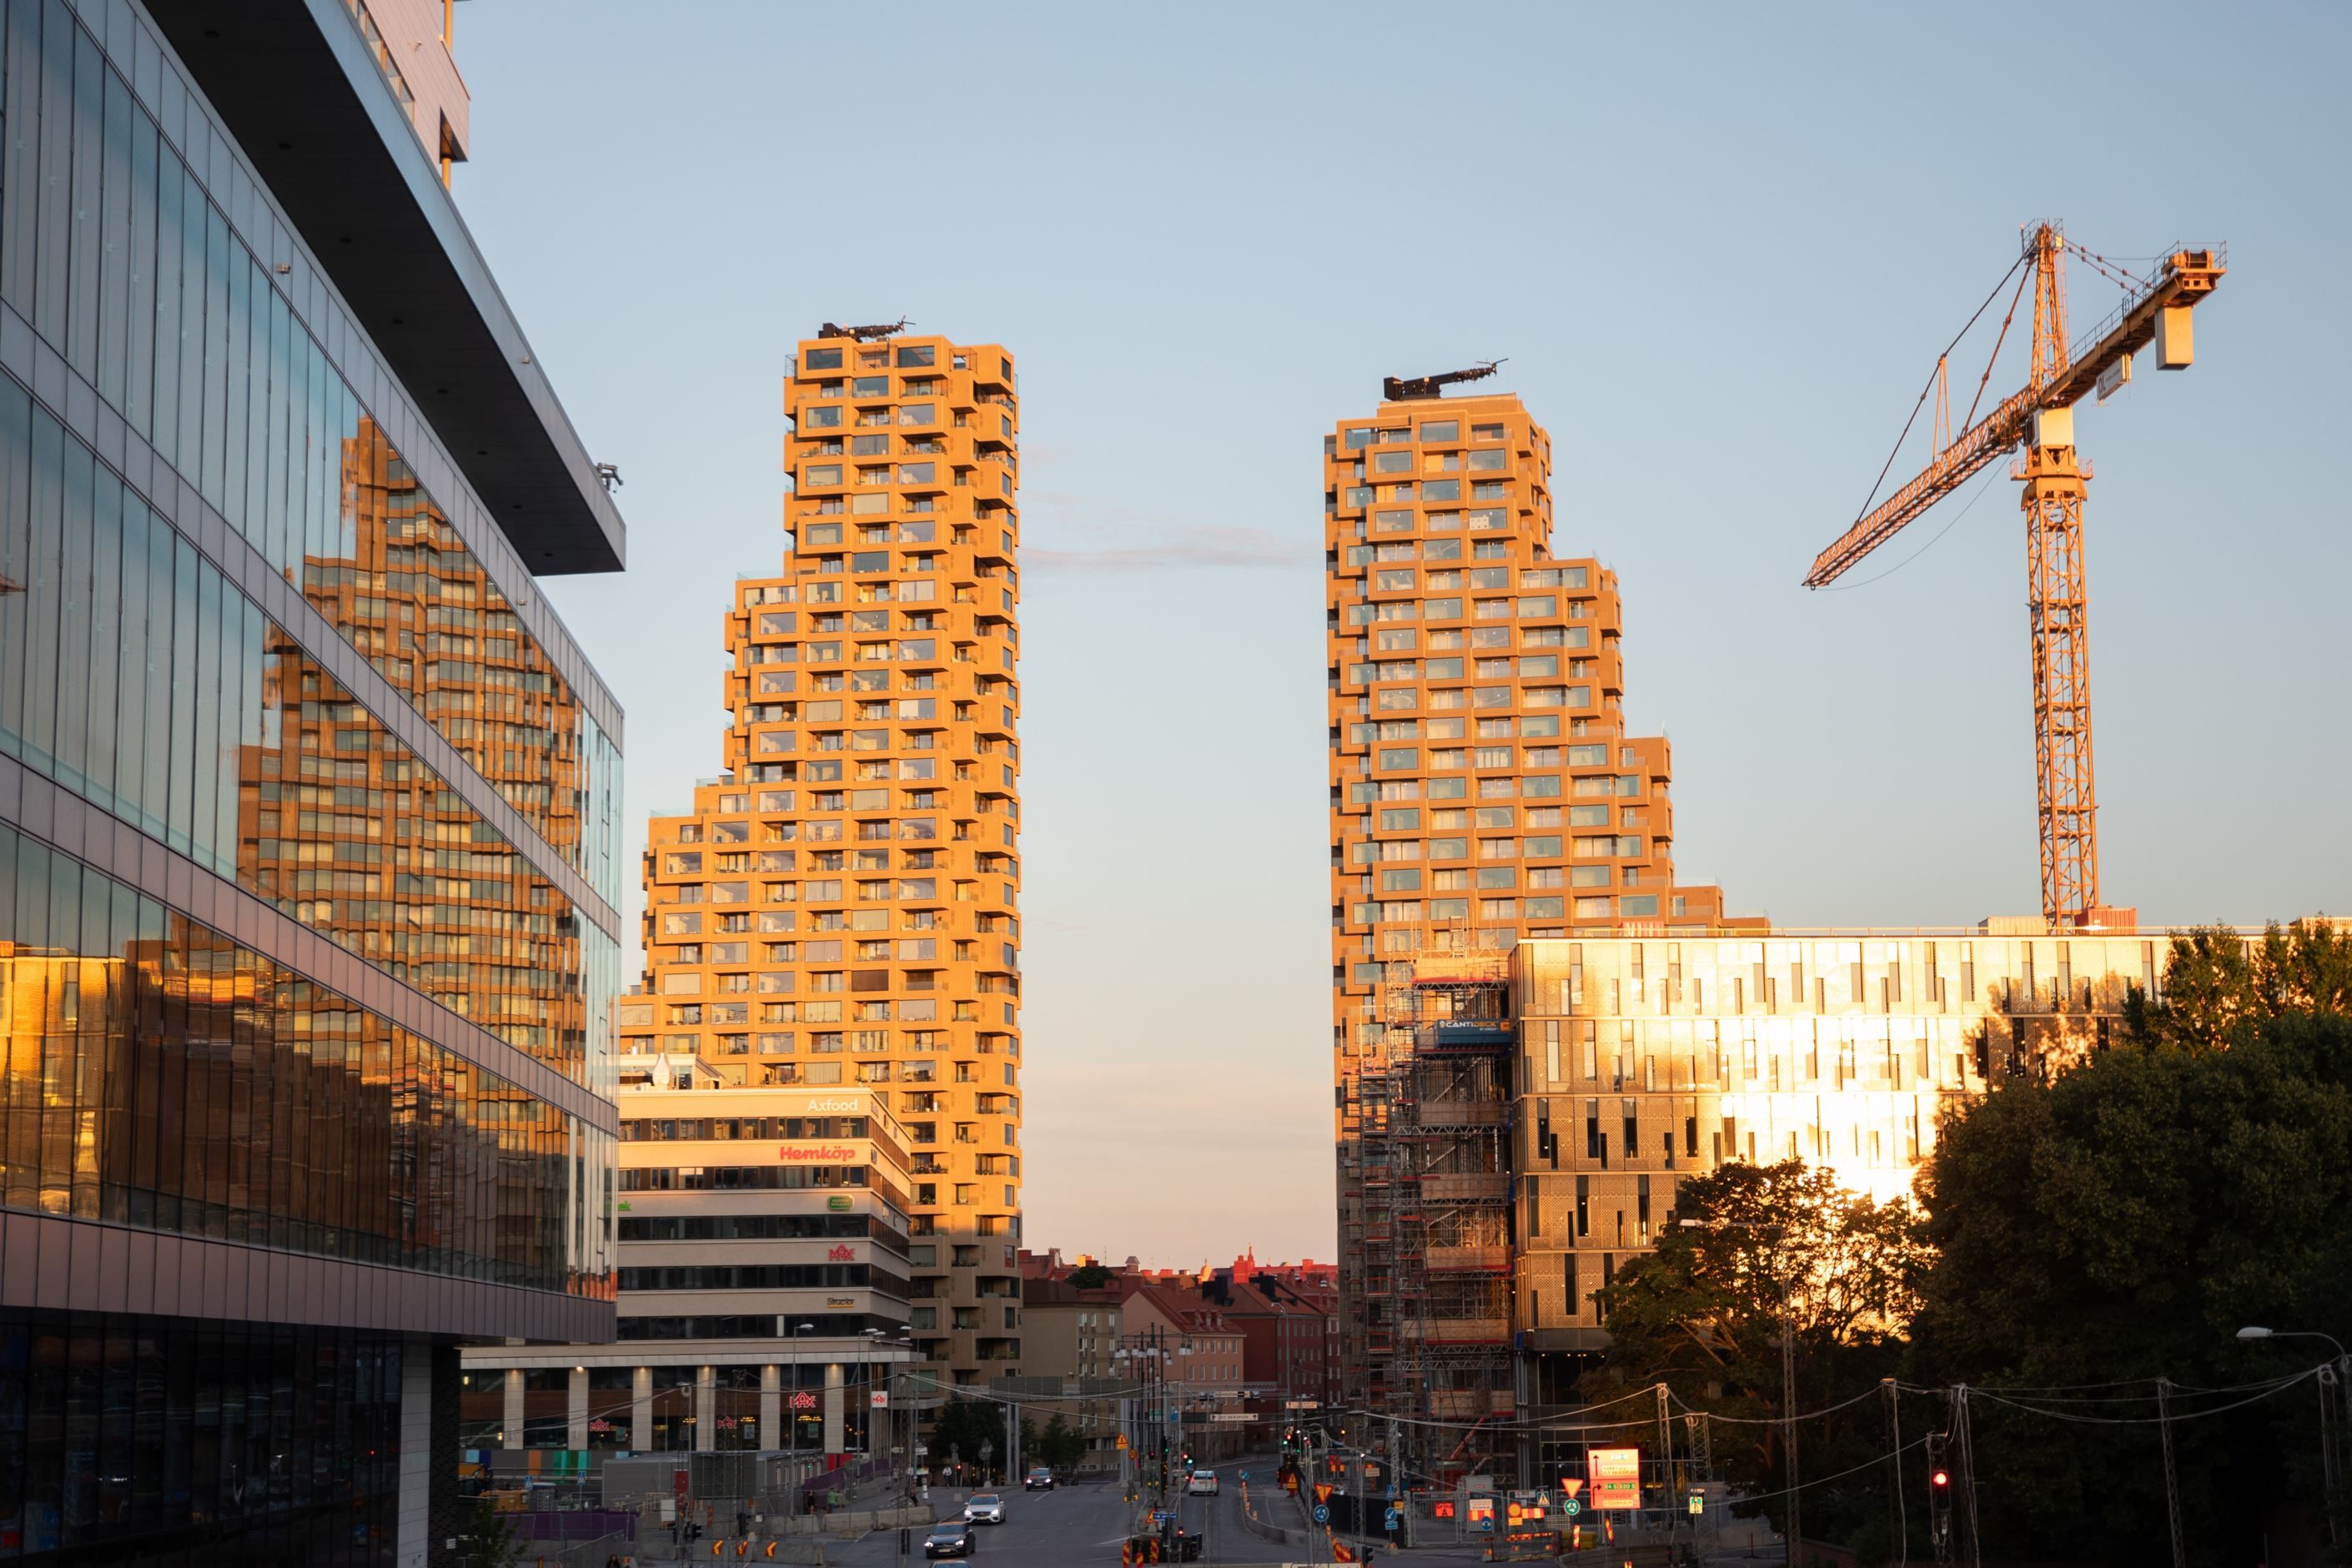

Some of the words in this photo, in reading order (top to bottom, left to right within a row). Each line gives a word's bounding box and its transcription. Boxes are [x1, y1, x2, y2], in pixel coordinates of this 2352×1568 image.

[807, 1098, 858, 1112] Axfood
[780, 1145, 856, 1162] Hemköp
[828, 1244, 855, 1261] MAX
[827, 1297, 854, 1305] Structor
[789, 1391, 817, 1408] MAX
[872, 1395, 886, 1404] MAX
[590, 1418, 610, 1431] MAX
